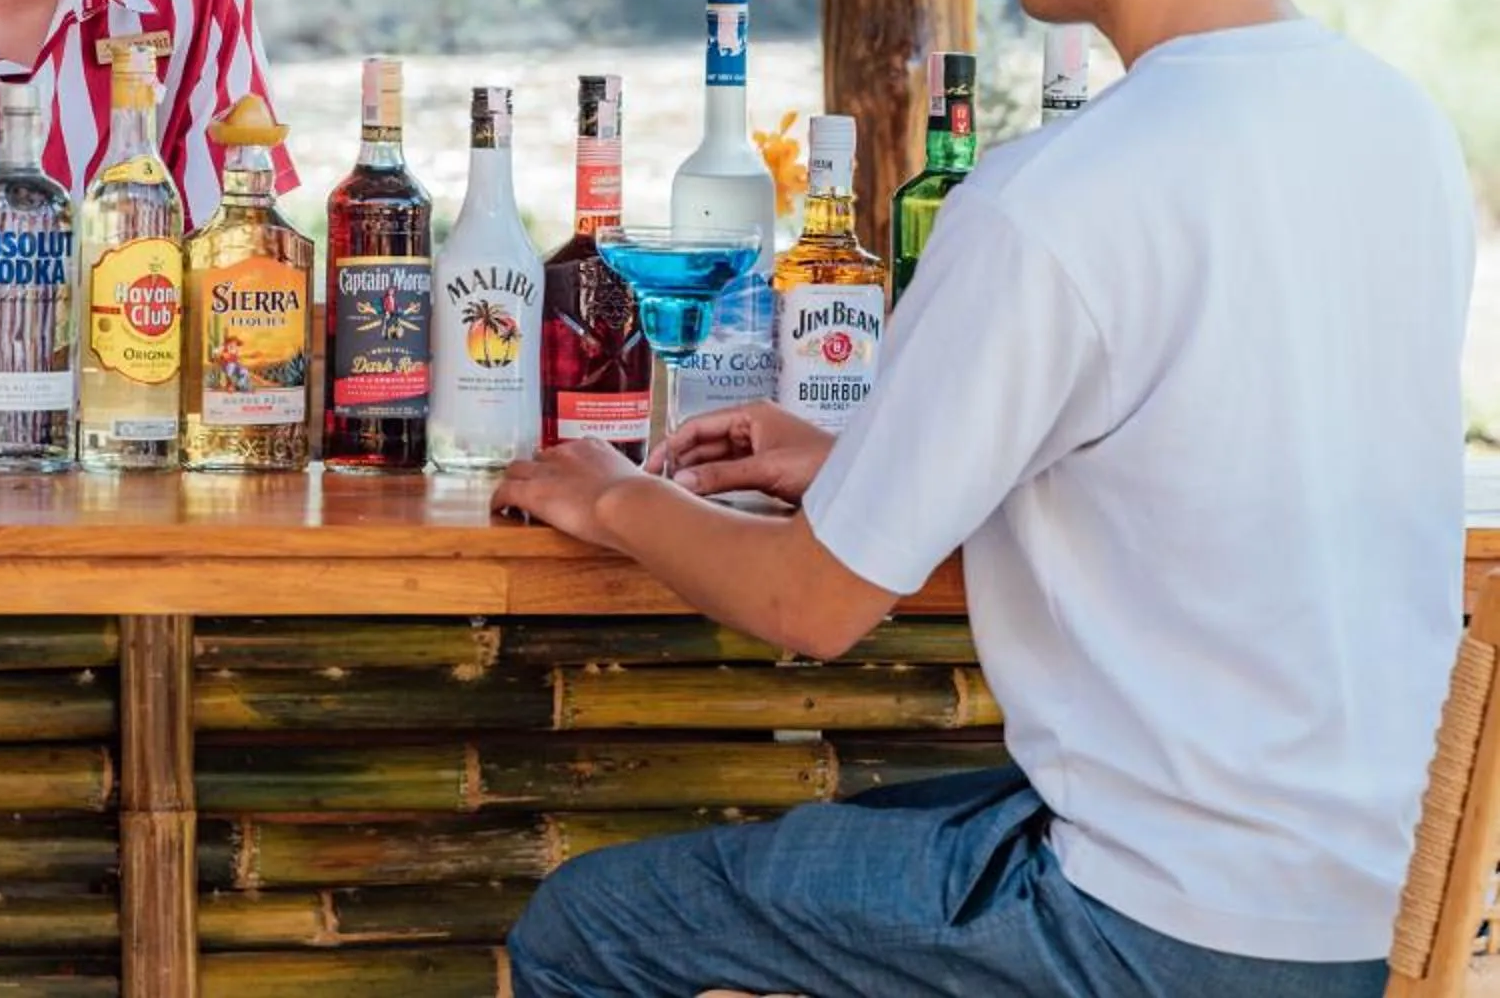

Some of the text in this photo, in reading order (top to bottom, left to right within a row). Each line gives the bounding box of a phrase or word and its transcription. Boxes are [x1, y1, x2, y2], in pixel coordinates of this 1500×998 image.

[339, 268, 389, 296] Captain
[446, 266, 538, 306] MALIBU
[211, 282, 299, 314] SIERRA
[130, 305, 171, 327] Club
[793, 301, 880, 340] JIM BEAM
[351, 355, 393, 374] Dark
[799, 382, 871, 402] BOURBON
